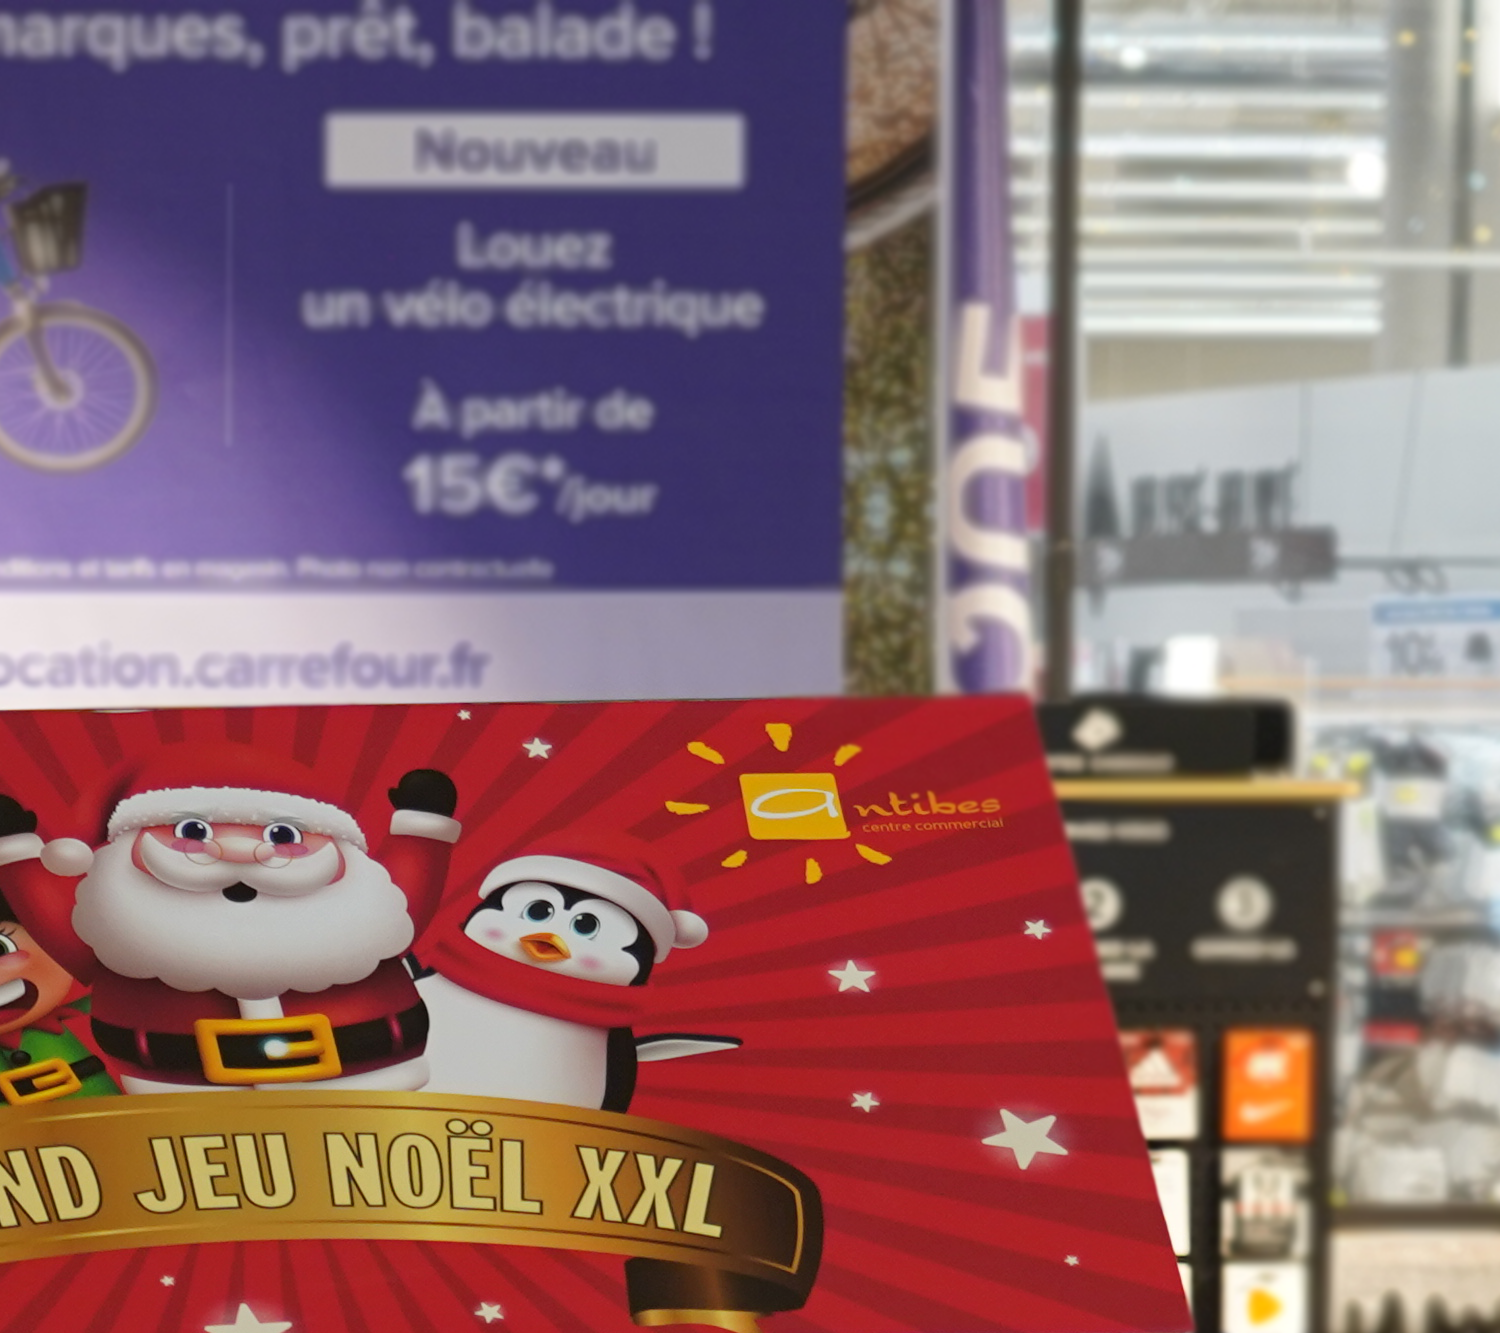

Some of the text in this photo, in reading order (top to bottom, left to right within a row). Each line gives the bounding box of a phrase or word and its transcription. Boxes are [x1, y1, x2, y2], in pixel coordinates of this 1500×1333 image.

[284, 2, 432, 70] prêt,
[455, 0, 676, 58] balade
[694, 2, 714, 58] !
[414, 131, 657, 176] Nouveau
[459, 225, 613, 270] Louez
[304, 281, 763, 338] un vélo électrique
[413, 380, 654, 443] À partir de
[862, 815, 1004, 834] centre commercial
[136, 1132, 297, 1214] JEU
[326, 1118, 542, 1214] NOËL
[571, 1143, 724, 1238] XXL
